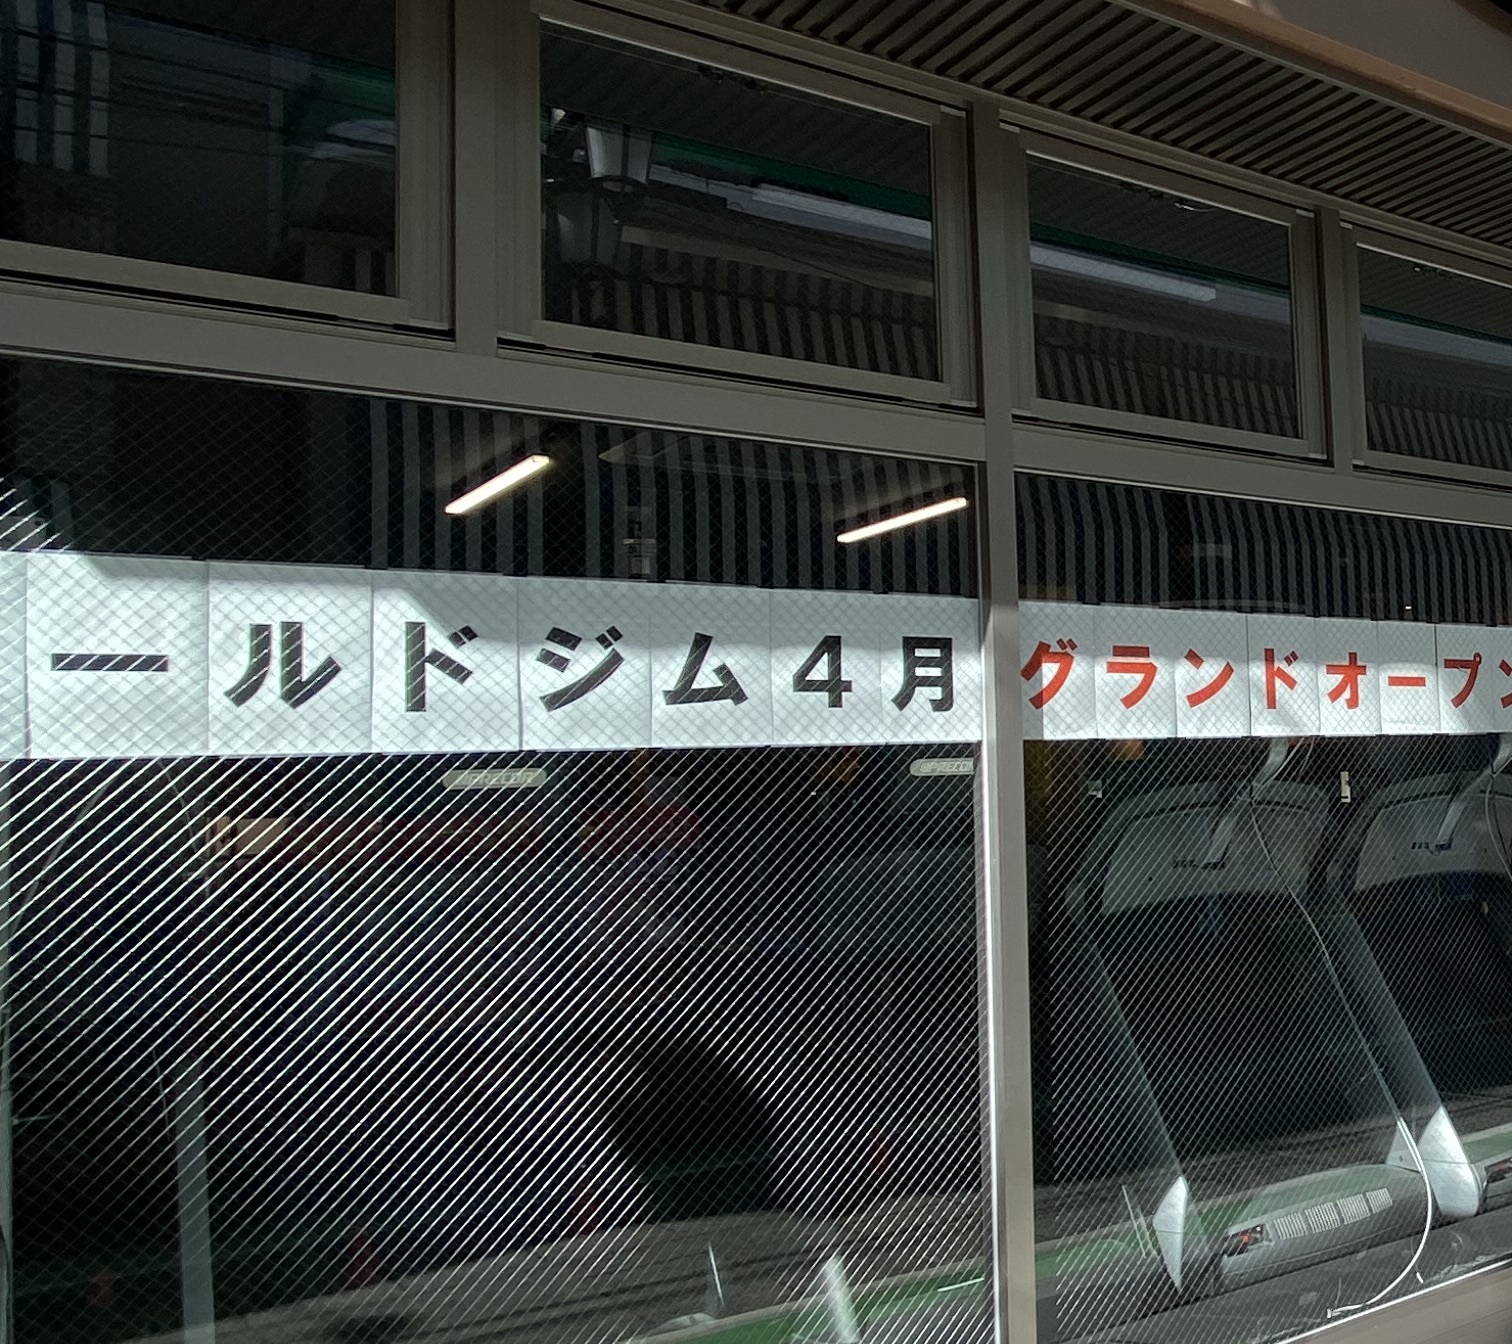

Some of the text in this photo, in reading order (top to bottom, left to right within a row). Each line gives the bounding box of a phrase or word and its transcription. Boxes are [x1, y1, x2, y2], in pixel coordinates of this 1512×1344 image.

[50, 621, 955, 713] ールドジム4月
